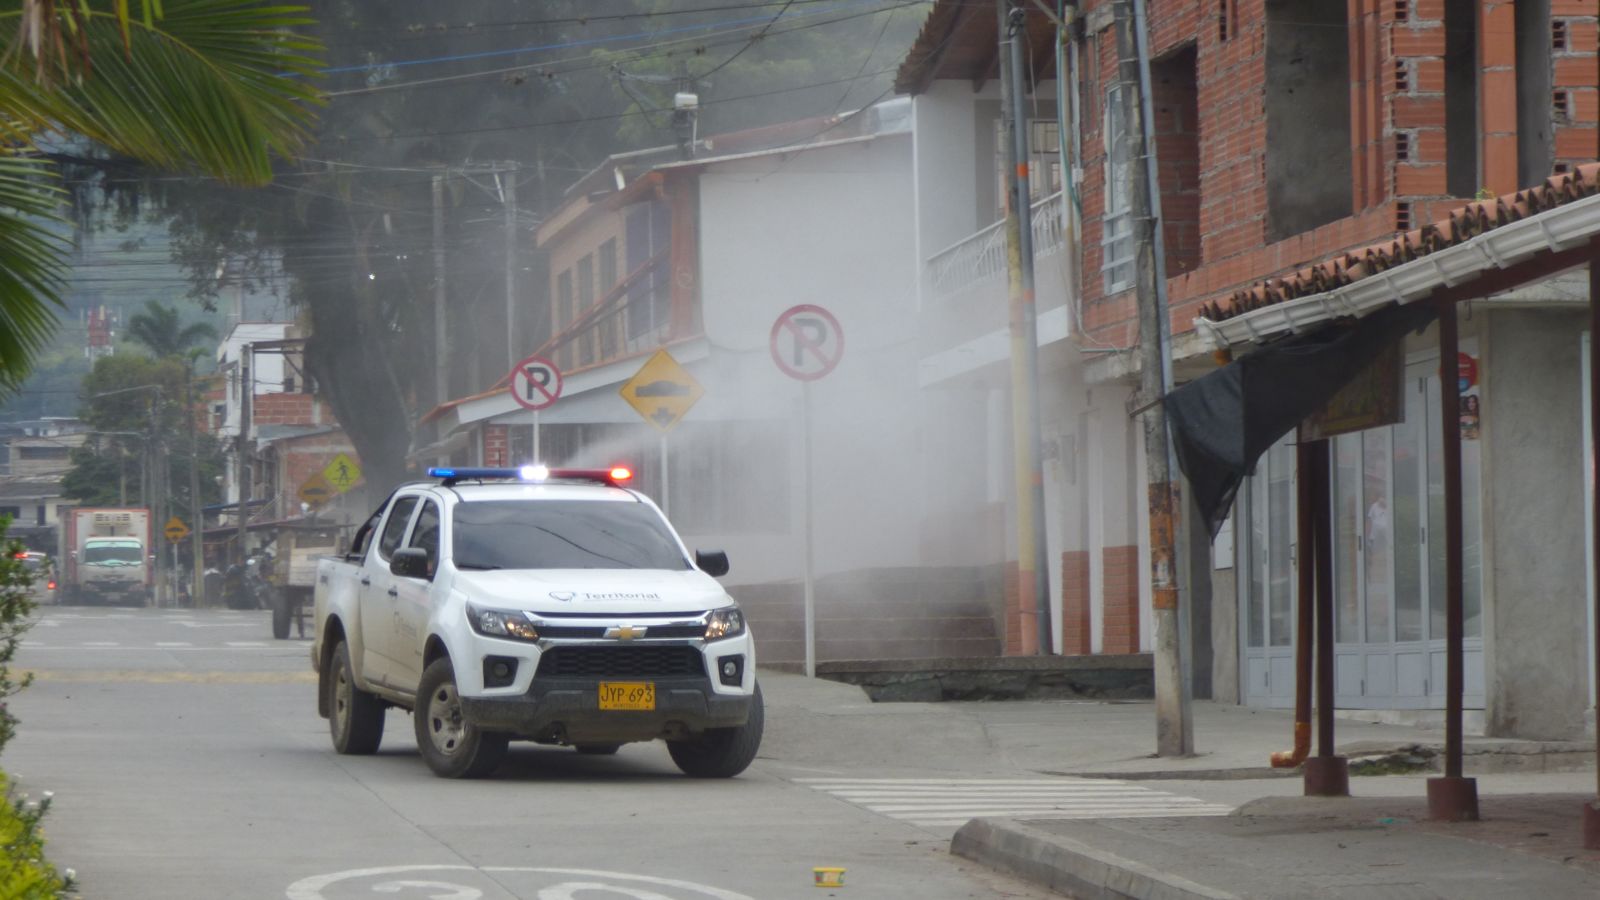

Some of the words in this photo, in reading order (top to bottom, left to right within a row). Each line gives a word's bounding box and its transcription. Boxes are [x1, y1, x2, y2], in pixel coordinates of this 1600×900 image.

[794, 318, 827, 367] P
[527, 367, 551, 400] P
[583, 592, 661, 600] Territorial
[601, 687, 625, 703] JYP
[629, 687, 653, 703] 693
